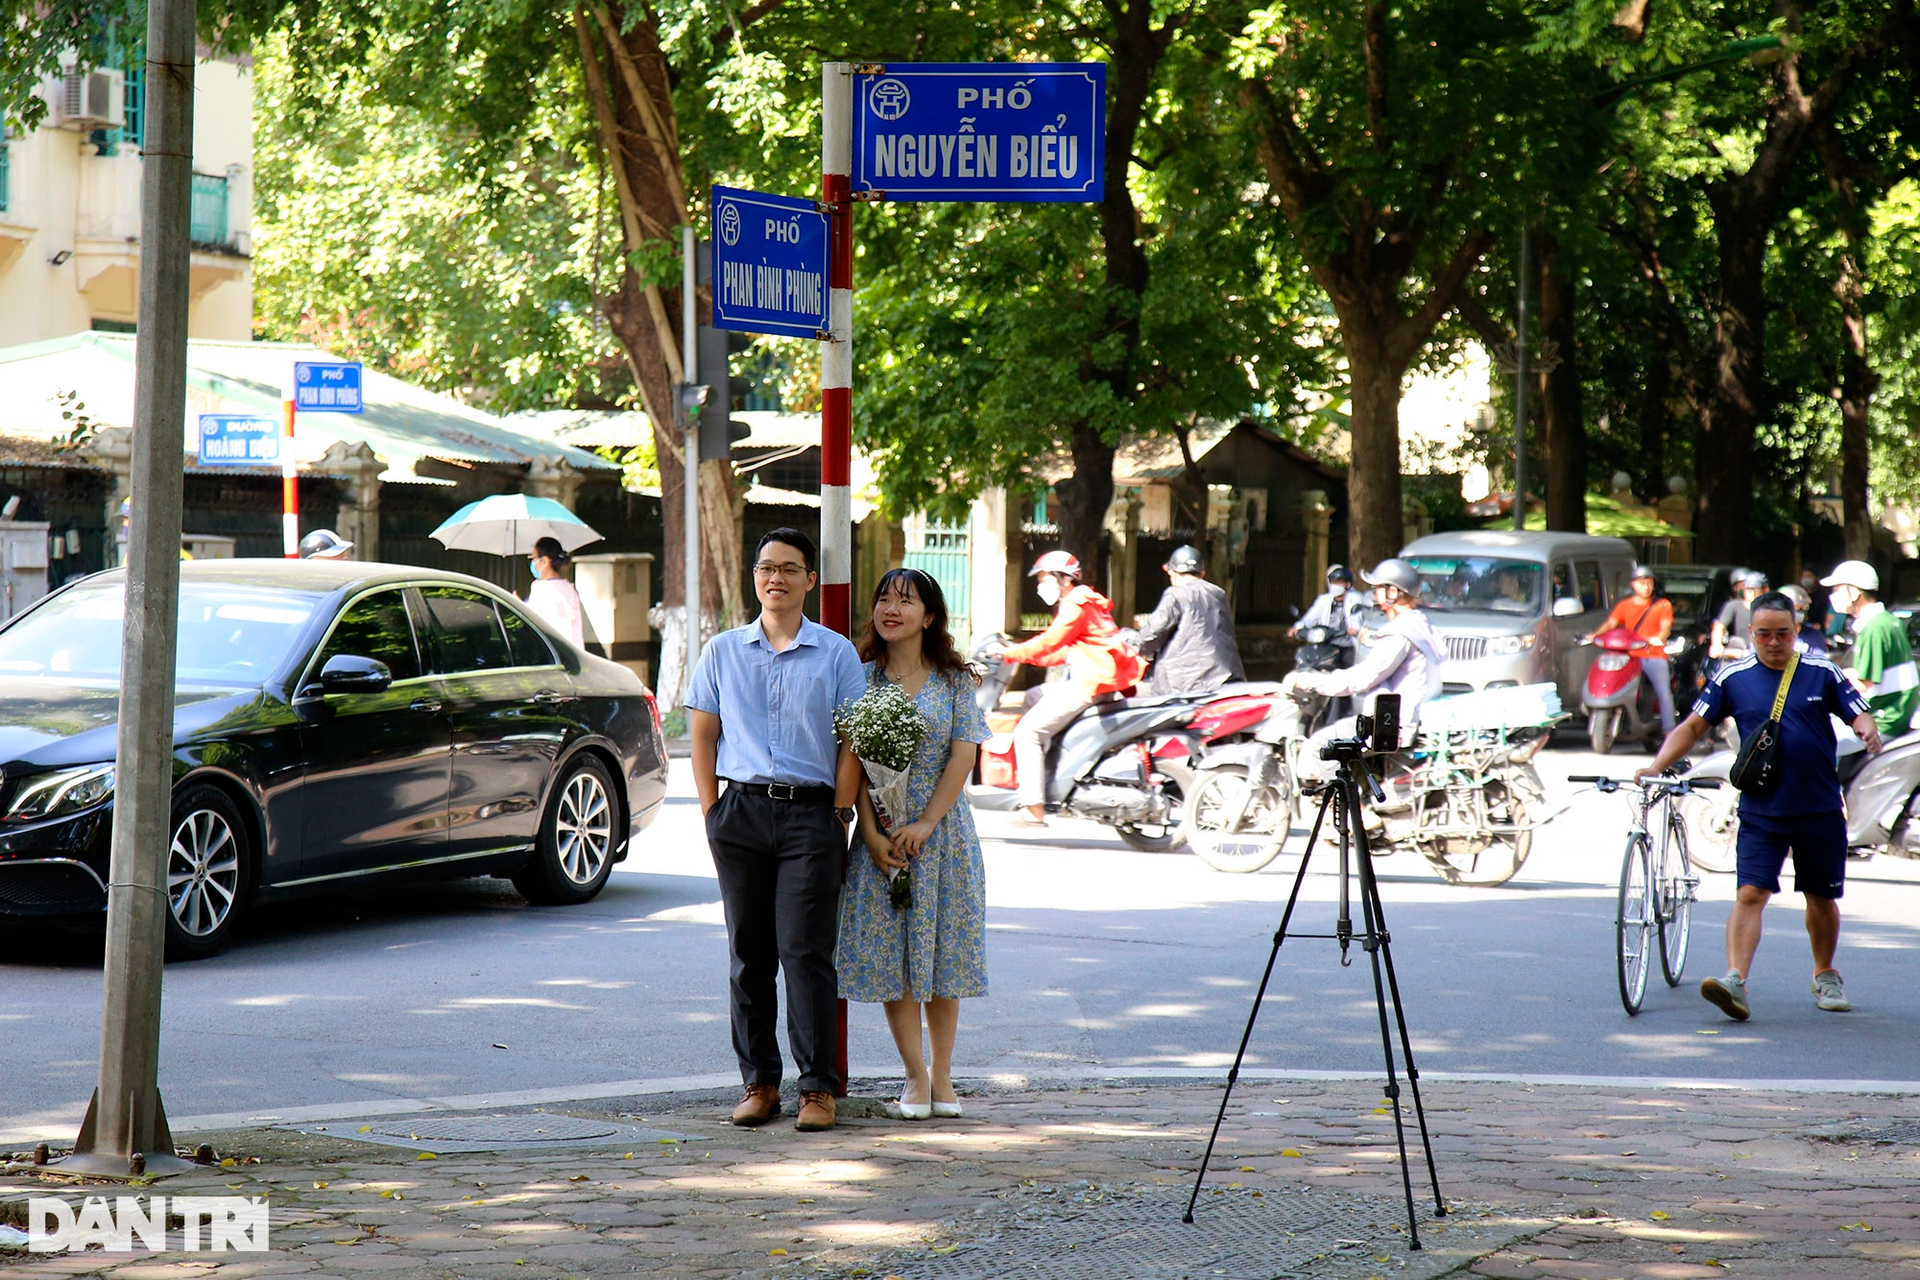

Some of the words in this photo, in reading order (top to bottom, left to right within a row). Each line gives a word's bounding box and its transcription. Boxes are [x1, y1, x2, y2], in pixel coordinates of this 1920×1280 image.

[957, 78, 1037, 110] PHỐ
[874, 116, 998, 178] NGUYỄN
[1009, 113, 1078, 179] BIỂU
[765, 213, 802, 245] PHỐ
[723, 260, 754, 308] PHAN
[756, 256, 783, 312] ĐÌNH
[785, 262, 822, 316] PHÙNG
[1383, 712, 1392, 726] 2
